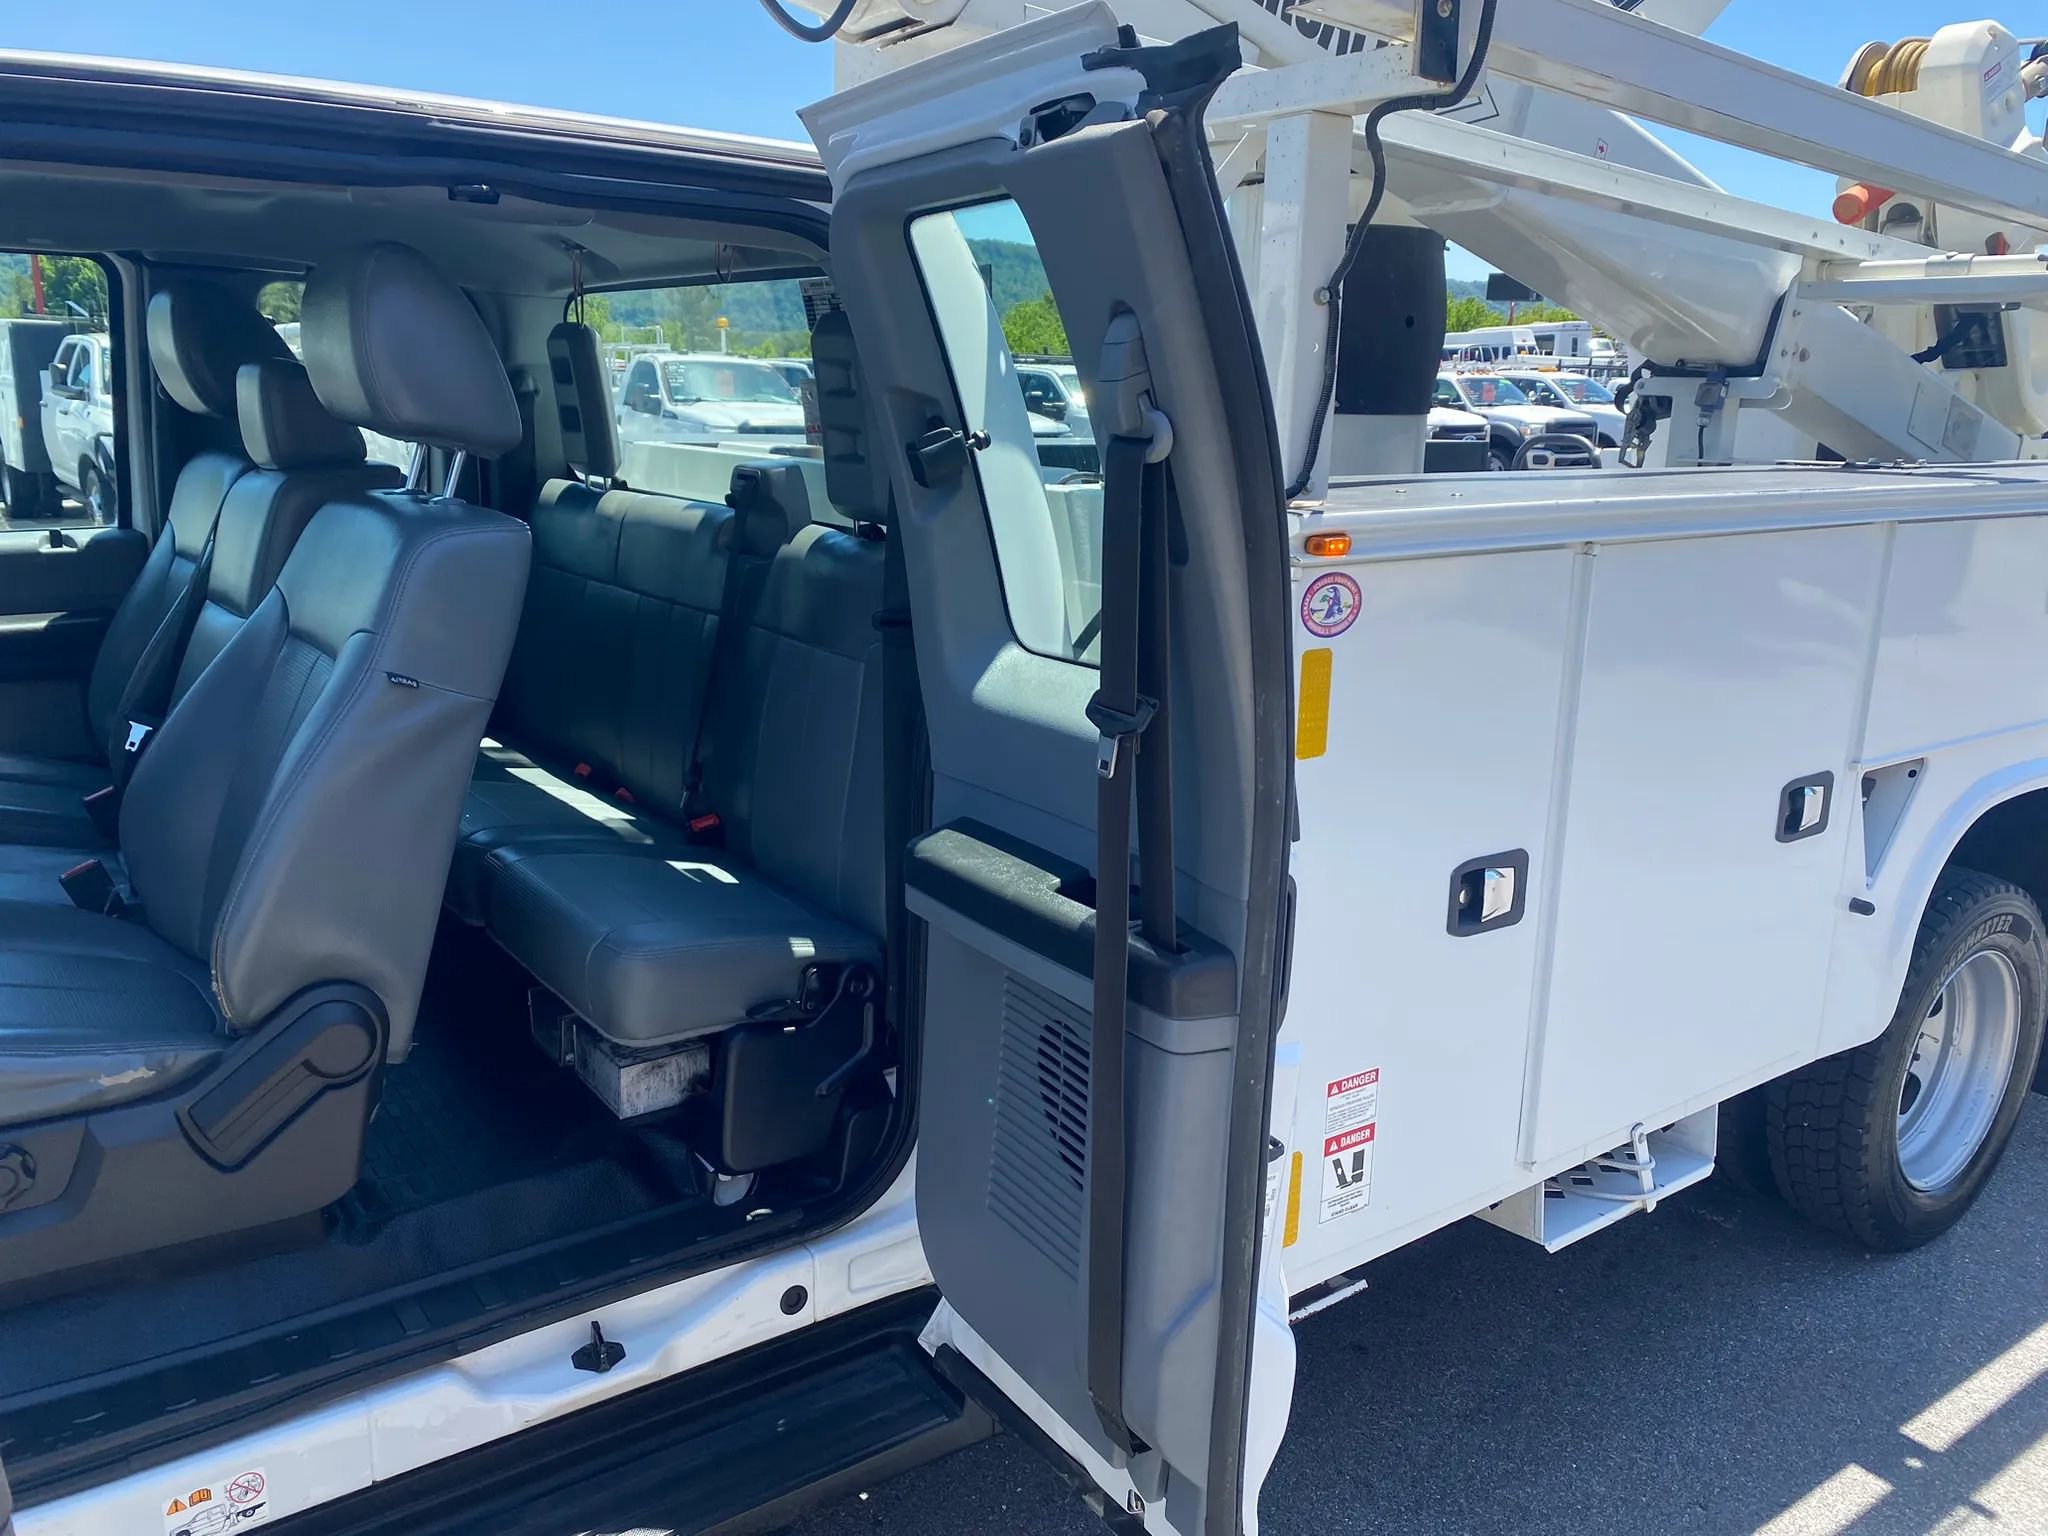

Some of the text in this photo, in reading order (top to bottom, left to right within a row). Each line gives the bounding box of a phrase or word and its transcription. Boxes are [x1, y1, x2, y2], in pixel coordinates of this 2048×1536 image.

[391, 677, 417, 688] AIRBAG
[1932, 915, 2014, 996] ROADMASTER
[1341, 1071, 1377, 1092] DANGER
[1340, 1128, 1371, 1148] DANGER
